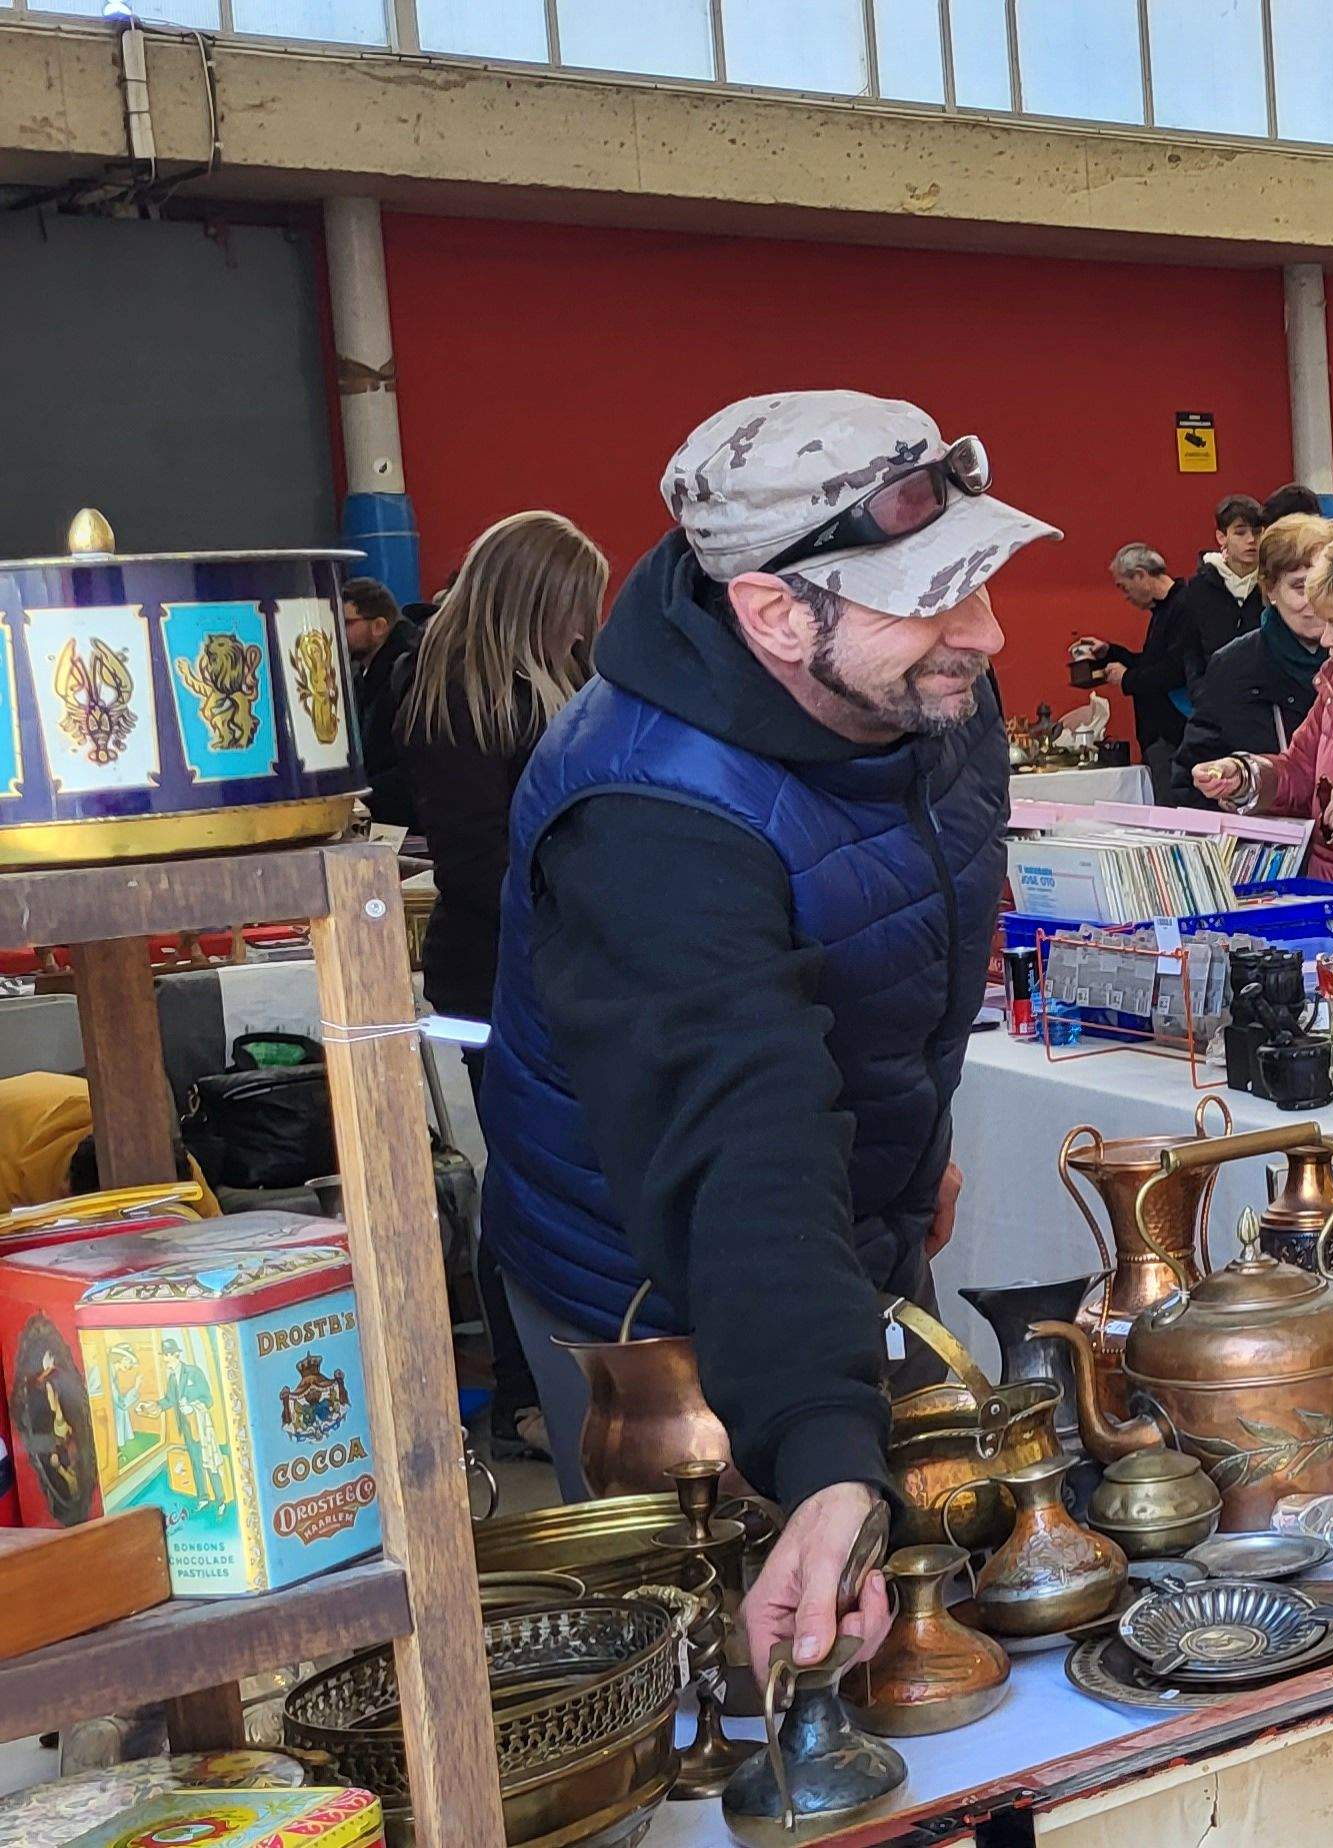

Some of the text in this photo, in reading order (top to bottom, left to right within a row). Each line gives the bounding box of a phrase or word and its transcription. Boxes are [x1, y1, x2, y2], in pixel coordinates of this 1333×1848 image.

[256, 1311, 357, 1358] DROSTE'S
[272, 1436, 368, 1490] COCOA
[303, 1511, 355, 1541] HAARLEM
[173, 1542, 226, 1552] BONBONS
[169, 1555, 235, 1566] CHOCOLADE
[177, 1568, 230, 1578] PASTILLES
